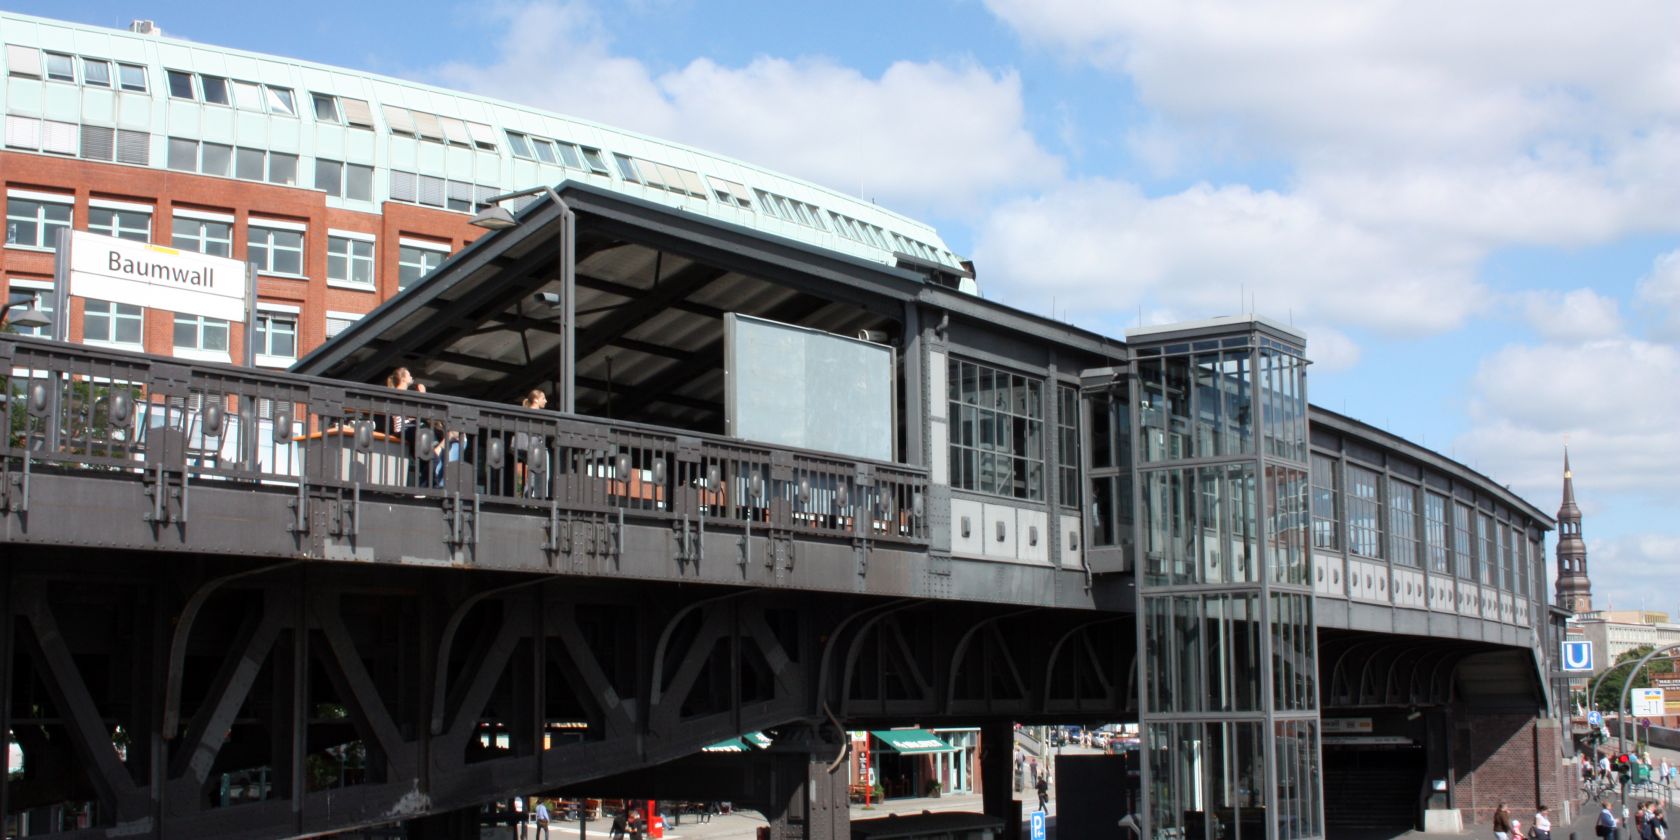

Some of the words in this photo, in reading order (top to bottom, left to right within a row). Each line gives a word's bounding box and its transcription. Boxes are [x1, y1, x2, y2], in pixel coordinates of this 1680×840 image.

[109, 251, 214, 287] Baumwall
[1566, 643, 1588, 668] U
[1034, 815, 1042, 838] P
